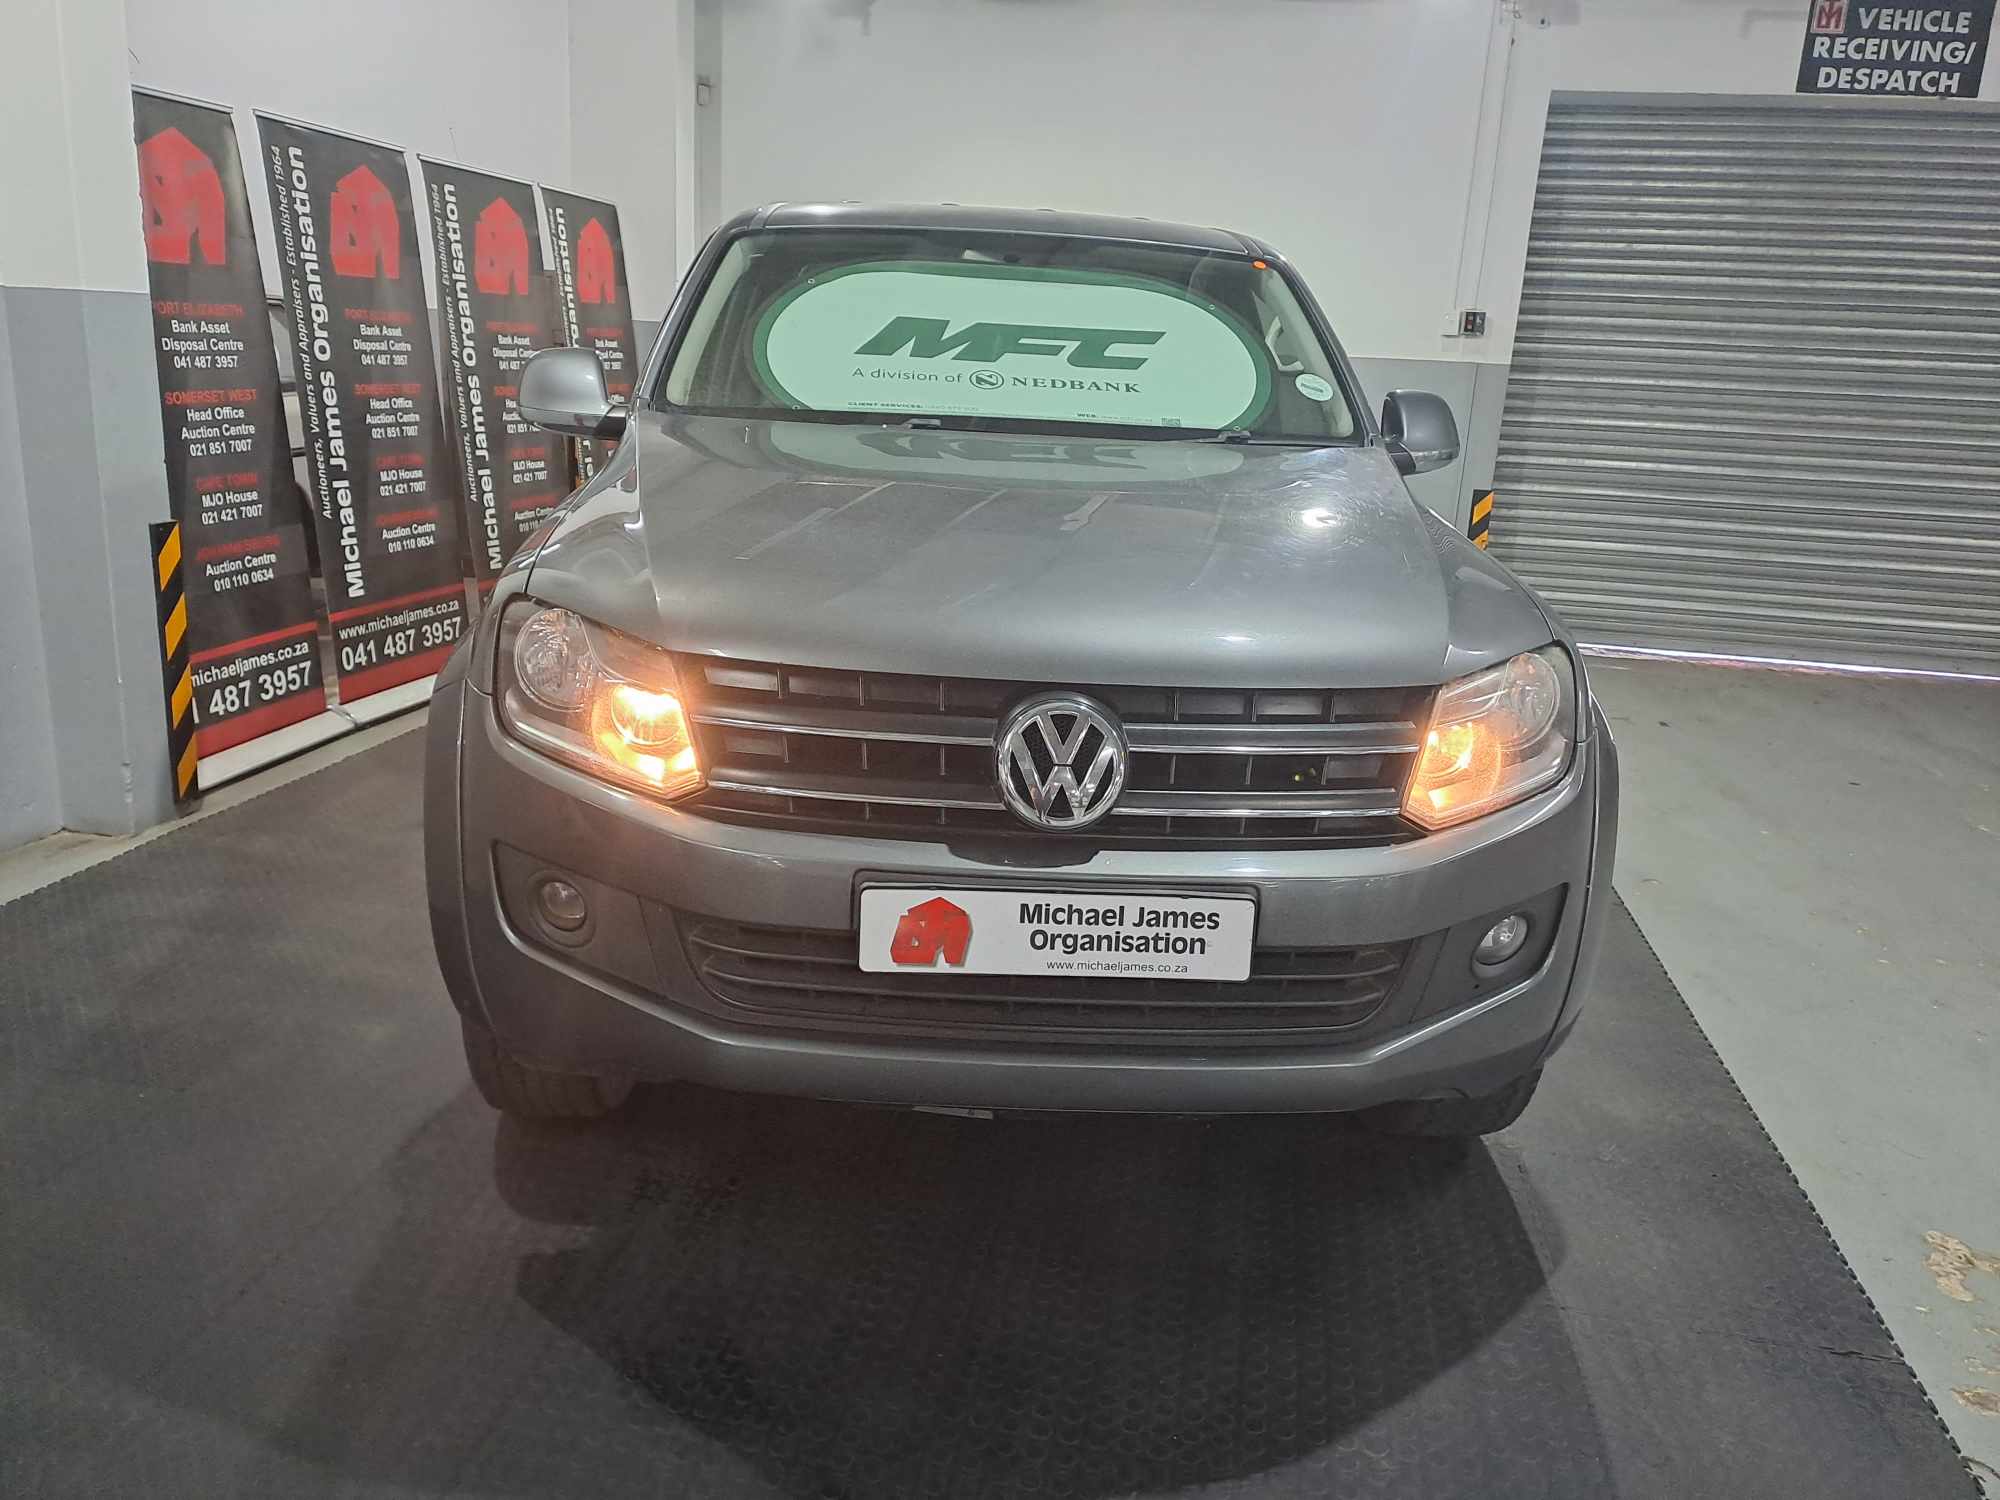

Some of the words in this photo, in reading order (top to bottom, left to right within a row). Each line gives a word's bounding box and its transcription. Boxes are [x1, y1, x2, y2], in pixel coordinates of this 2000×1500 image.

[1859, 8, 1972, 33] VEHICLE
[1813, 37, 1976, 64] RECEIVING/
[1817, 67, 1960, 94] DESPATCH
[270, 145, 285, 181] 1964
[276, 185, 297, 266] Established
[288, 146, 332, 361] Organisation
[443, 183, 477, 367] Organisation
[171, 320, 199, 333] Bank
[200, 321, 230, 334] Asset
[291, 278, 310, 349] Appraisers
[445, 296, 459, 358] Appraisers
[360, 324, 381, 336] Bank
[853, 316, 1168, 370] MFC
[161, 338, 208, 354] Disposal
[210, 338, 244, 351] Centre
[353, 339, 388, 352] Disposal
[174, 356, 192, 368] 041
[194, 356, 212, 368] 487
[215, 356, 238, 368] 3957
[302, 354, 313, 381] and
[452, 359, 463, 383] and
[852, 367, 864, 378] A
[870, 368, 938, 382] division
[944, 373, 963, 383] of
[1010, 376, 1143, 394] NEDBANK
[187, 408, 212, 421] Head
[214, 407, 245, 420] Office
[305, 384, 320, 434] Valuers
[370, 398, 390, 410] Head
[457, 386, 470, 429] Valuers
[319, 370, 348, 472] James
[366, 411, 396, 425] Auction
[467, 375, 490, 462] James
[181, 426, 220, 440] Auction
[222, 424, 256, 437] Centre
[372, 427, 386, 439] 021
[190, 444, 207, 456] 021
[209, 443, 227, 455] 851
[229, 439, 252, 453] 7007
[311, 438, 332, 519] Auctioneers,
[399, 468, 422, 480] House
[202, 493, 224, 508] MJO
[225, 490, 258, 504] House
[202, 511, 219, 525] 021
[220, 509, 238, 523] 421
[240, 504, 263, 519] 7007
[477, 468, 503, 571] Michael
[332, 479, 366, 599] Michael
[382, 525, 412, 540] Auction
[205, 559, 243, 577] Auction
[244, 553, 277, 571] Centre
[213, 577, 231, 592] 010
[232, 572, 249, 588] 110
[251, 567, 274, 583] 0634
[339, 600, 460, 641] www.michaeljames.co.za
[341, 640, 377, 671] 041
[383, 628, 416, 657] 487
[421, 616, 462, 647] 3957
[209, 680, 251, 716] 487
[258, 661, 311, 701] 3957
[1019, 903, 1125, 927] Michael
[1132, 906, 1220, 930] James
[1029, 929, 1206, 955] Organisation
[1046, 960, 1188, 974] www.michaeljames.co.za
